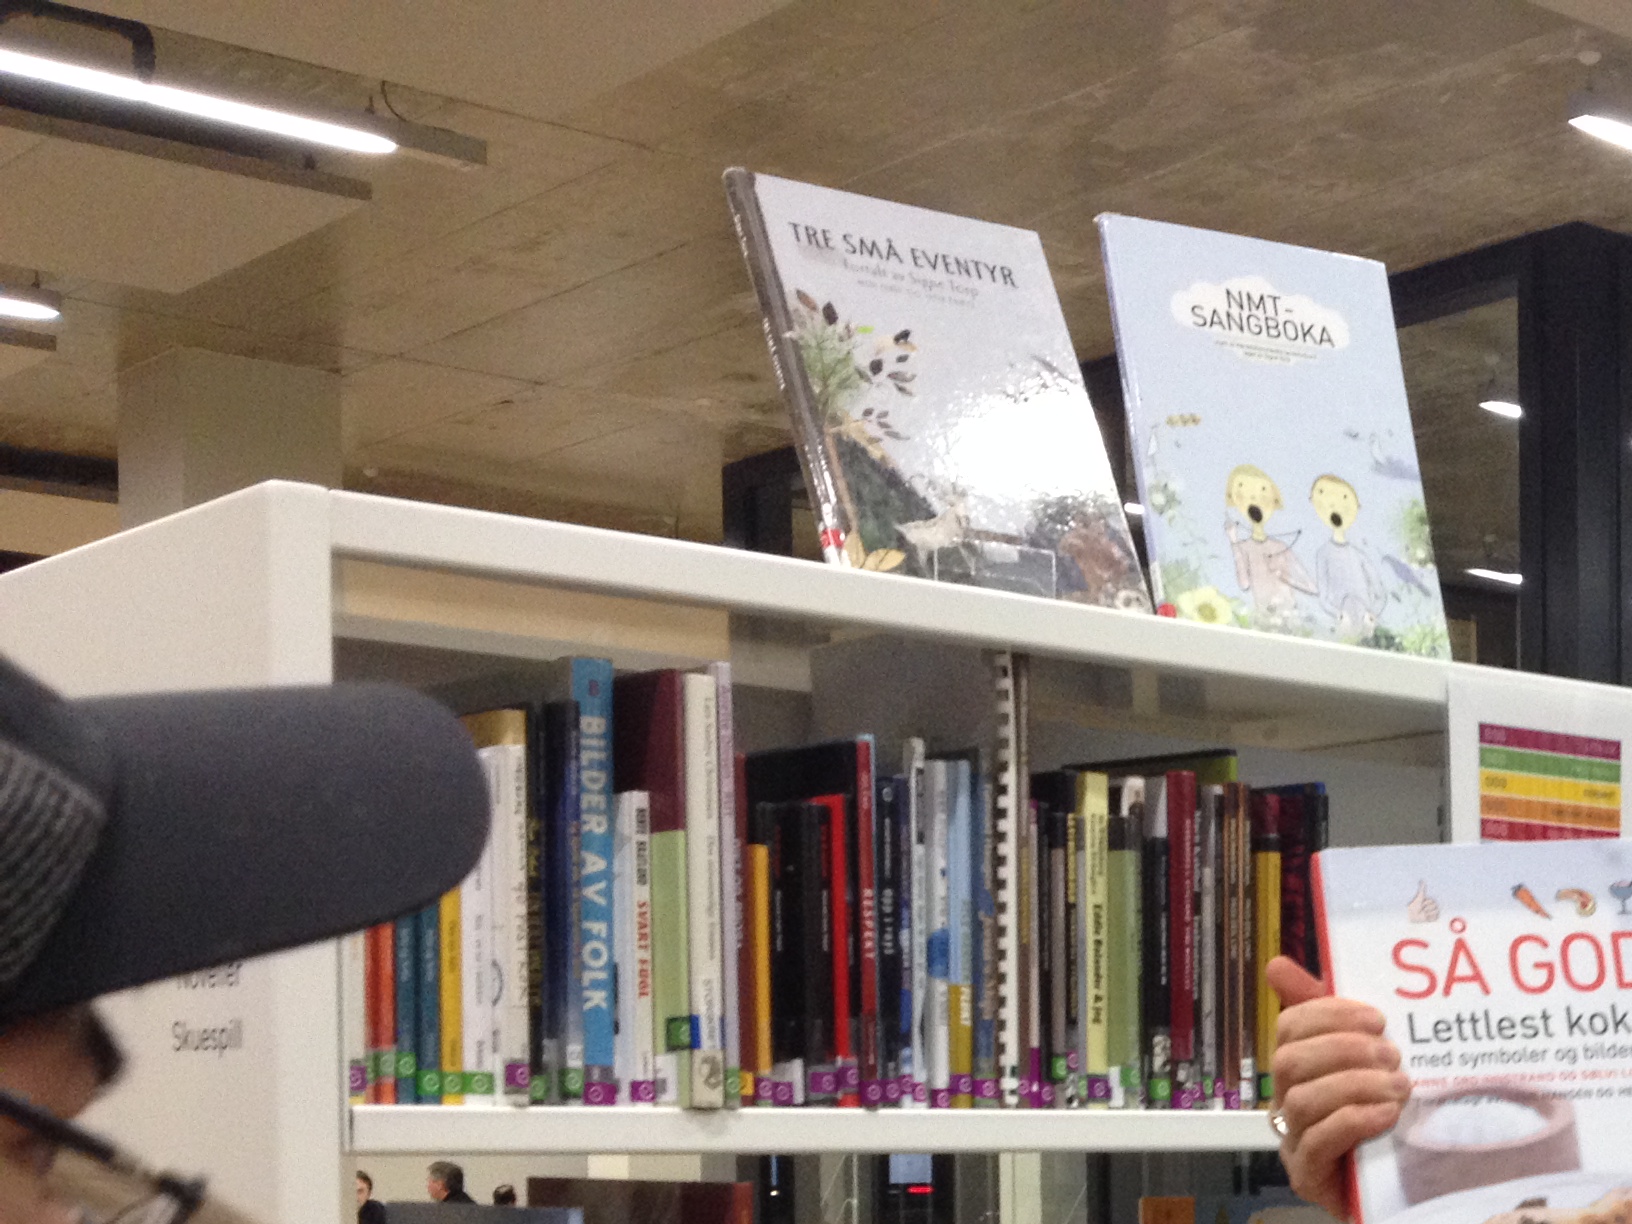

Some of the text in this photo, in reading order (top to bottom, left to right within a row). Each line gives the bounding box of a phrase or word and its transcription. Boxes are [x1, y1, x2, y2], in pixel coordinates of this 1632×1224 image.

[789, 221, 835, 250] TRE
[842, 233, 904, 264] SMÅ
[910, 247, 1019, 288] EVENTYR
[1226, 287, 1294, 316] NMT-
[1190, 304, 1336, 349] SANGBOKA
[579, 715, 608, 1010] BILDER AV FOLK
[637, 900, 649, 950] SVART
[862, 888, 875, 959] RESPEKT
[1391, 916, 1491, 1000] SÅ
[171, 1018, 244, 1060] Skuespill
[1406, 1008, 1555, 1045] Lettlest
[1410, 1051, 1452, 1067] med
[1458, 1047, 1548, 1069] symboler
[1554, 1048, 1578, 1065] og
